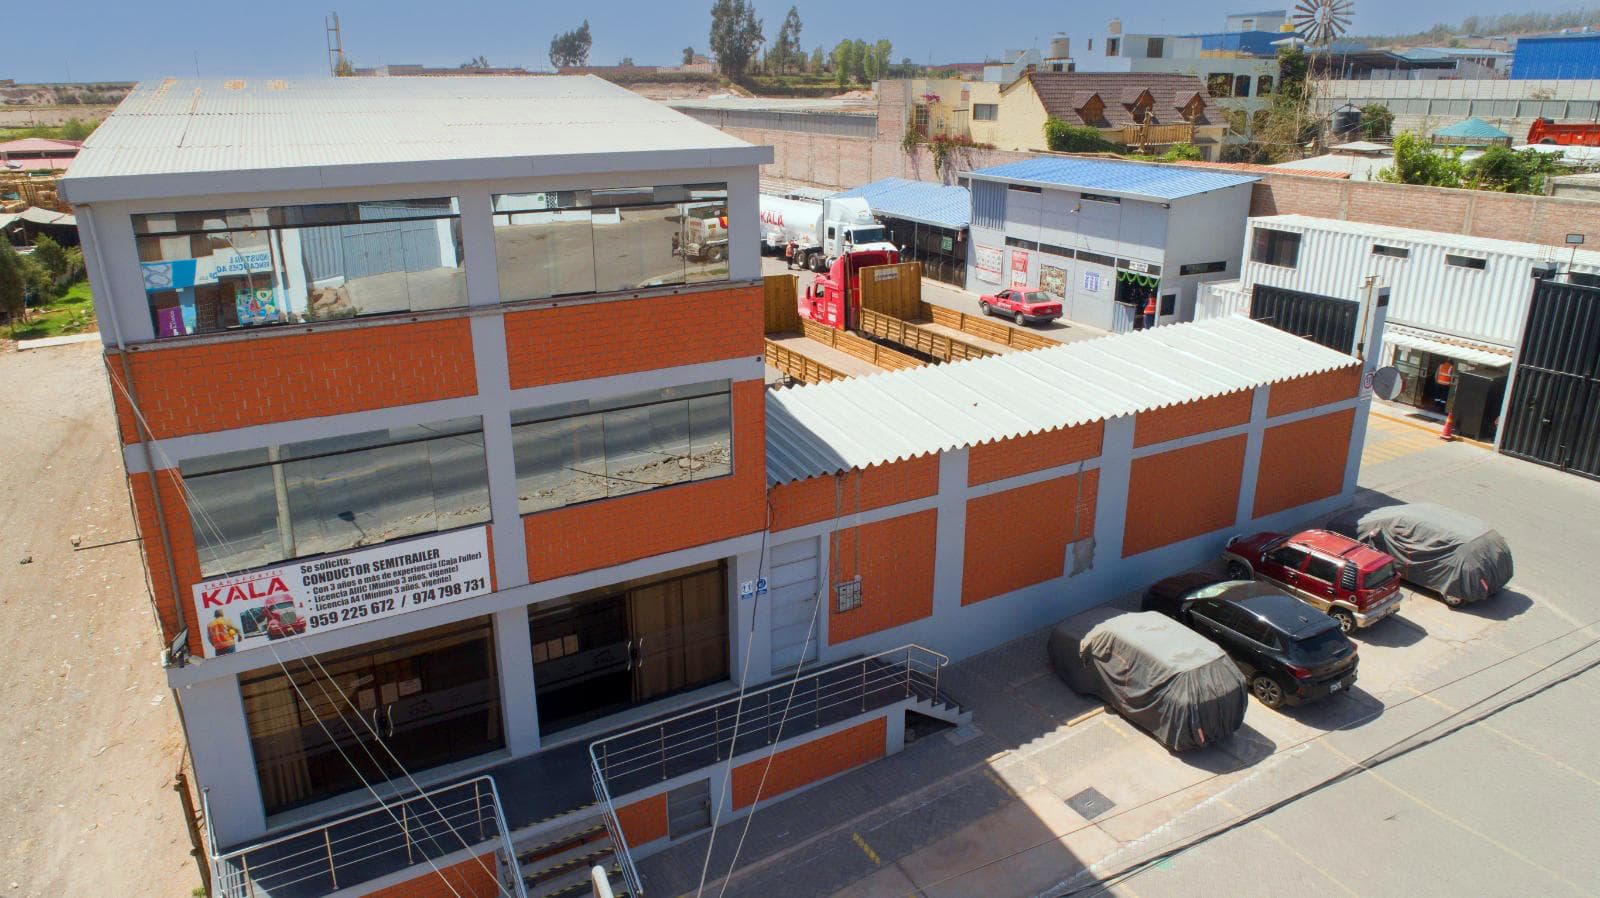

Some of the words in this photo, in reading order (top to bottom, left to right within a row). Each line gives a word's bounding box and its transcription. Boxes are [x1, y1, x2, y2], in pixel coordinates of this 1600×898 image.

[760, 209, 785, 227] KALA
[203, 569, 284, 590] TRANSPORTES
[300, 565, 313, 574] Se
[314, 558, 352, 572] solicita:
[302, 563, 371, 587] CONDUCTOR
[372, 548, 440, 572] SEMITRAILER
[313, 585, 329, 595] Con
[330, 583, 336, 591] 3
[336, 579, 357, 589] años
[381, 571, 392, 580] de
[392, 562, 437, 578] experiencia
[438, 557, 458, 568] (Caja
[458, 551, 482, 563] Fuller)
[314, 589, 348, 603] Licencia
[428, 565, 459, 579] vigente)
[201, 576, 290, 609] KALA
[309, 611, 339, 629] 959
[340, 604, 368, 622] 225
[370, 598, 395, 614] 672
[401, 594, 406, 608] /
[412, 588, 436, 605] 974
[437, 583, 462, 599] 798
[464, 577, 485, 593] 731
[315, 597, 350, 612] Licencia
[350, 596, 360, 605] A4
[421, 574, 452, 588] vigente)
